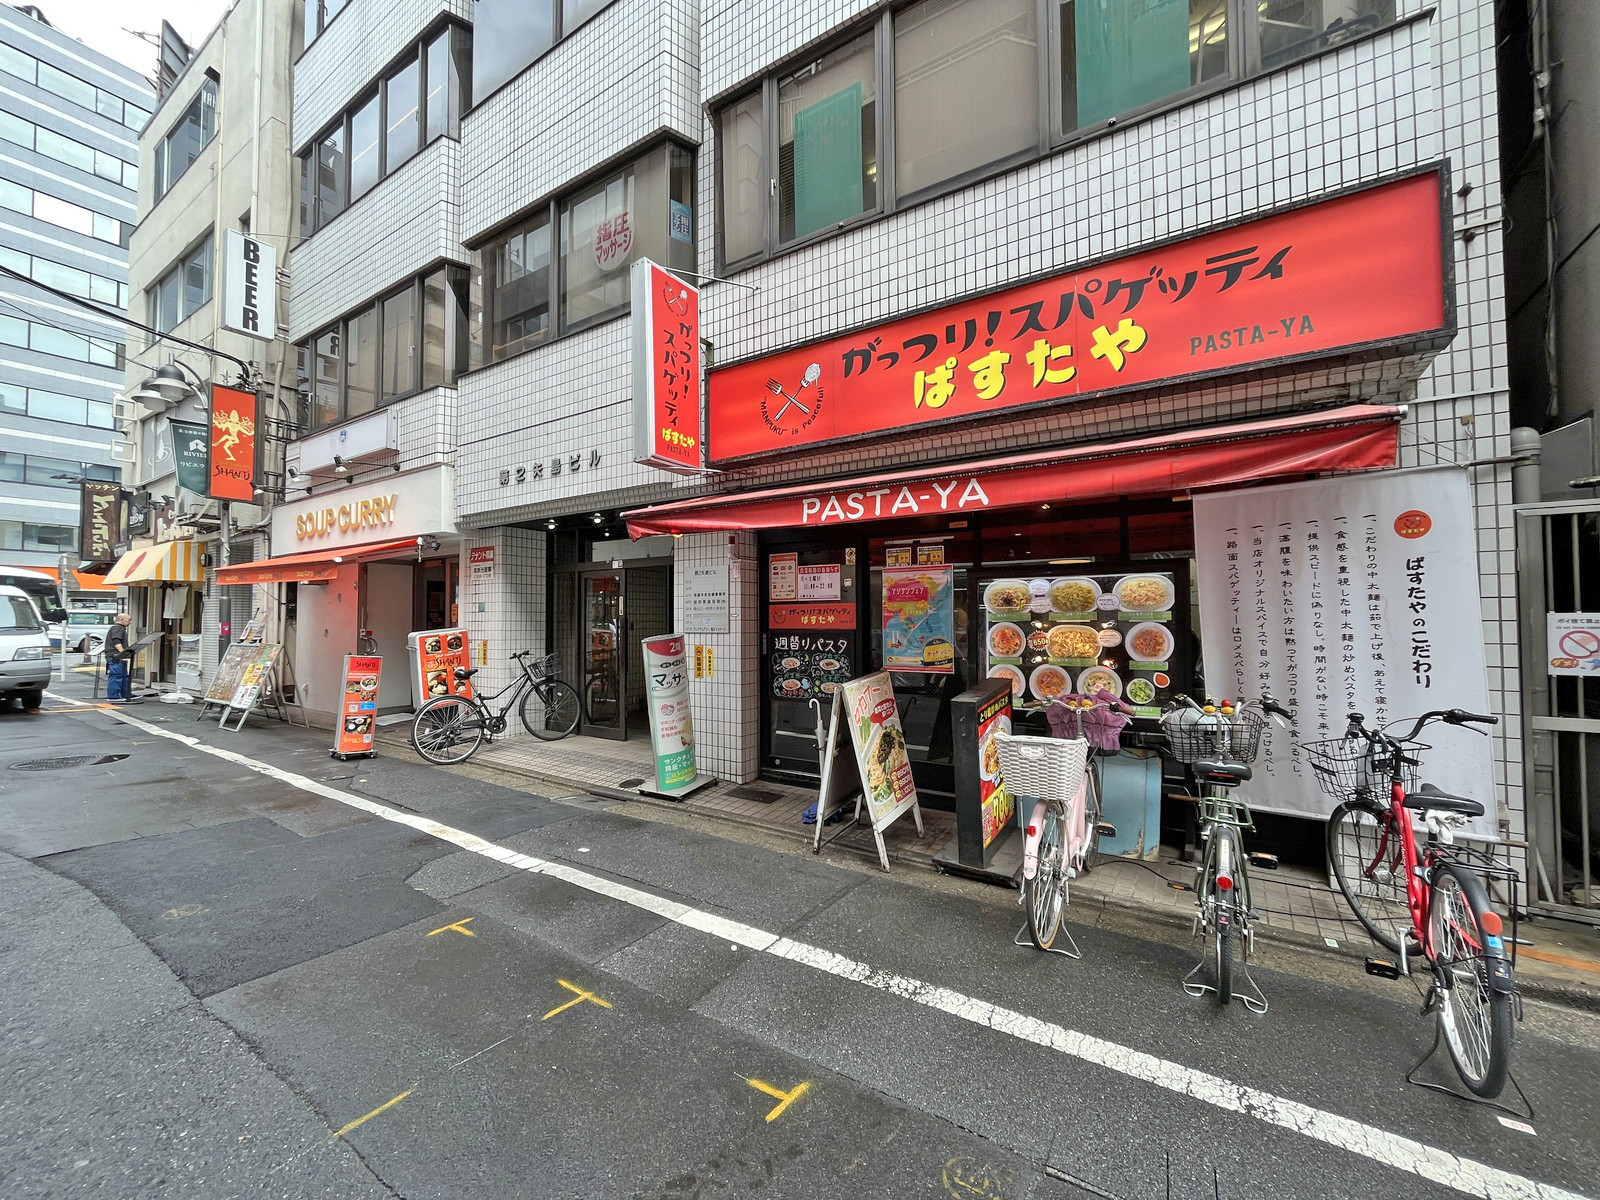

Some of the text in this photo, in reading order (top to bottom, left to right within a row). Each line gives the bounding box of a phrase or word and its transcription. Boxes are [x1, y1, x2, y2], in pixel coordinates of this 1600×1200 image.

[597, 212, 629, 245] 指圧
[243, 238, 260, 333] BEER
[1190, 315, 1316, 356] PASTA-YA
[663, 329, 679, 427] スパゲッティ
[914, 317, 1149, 409] ぱすたや
[662, 428, 695, 449] ぱすたや
[667, 444, 690, 457] PASTA-YA
[296, 493, 399, 540] SOUP CURRY
[802, 478, 989, 523] PASTA-YA
[774, 635, 848, 654] 週替りパスタ
[1406, 556, 1433, 689] ぱすたやのこだわり
